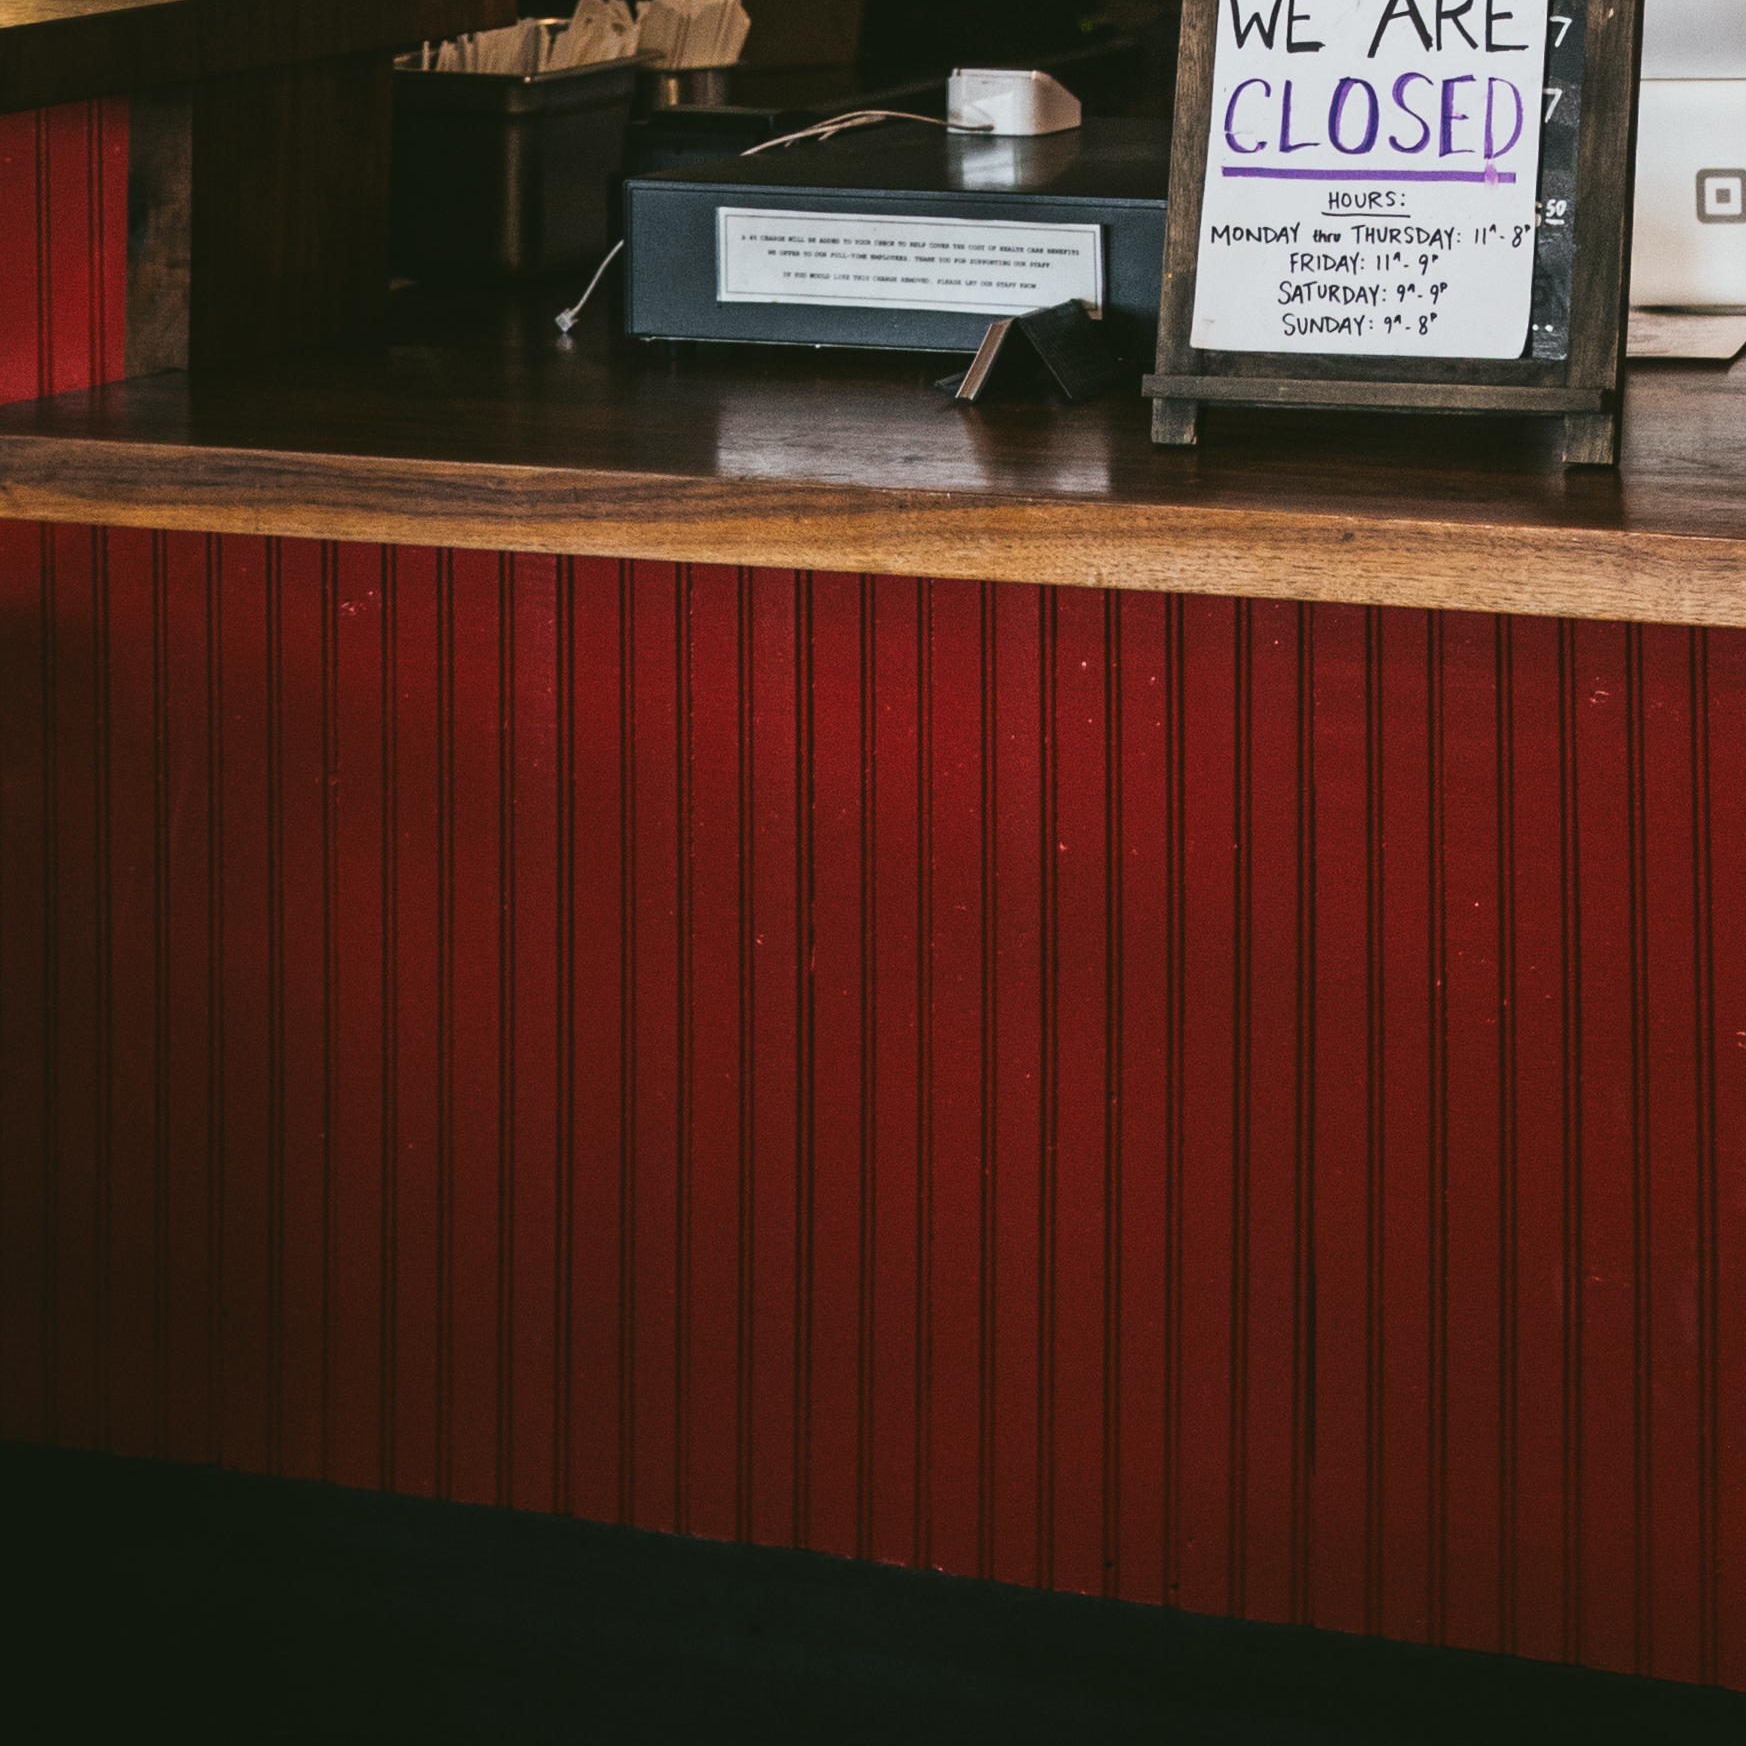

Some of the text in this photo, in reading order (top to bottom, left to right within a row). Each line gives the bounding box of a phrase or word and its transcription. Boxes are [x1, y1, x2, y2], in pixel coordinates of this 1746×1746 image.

[1223, 72, 1523, 159] CLOSED
[1328, 191, 1407, 209] HOURS:
[1211, 222, 1461, 250] MONDAY thru THURSDAY:
[1290, 253, 1365, 273] FRIDAY:
[1278, 281, 1387, 306] SATURDAY:
[1282, 313, 1373, 336] SUNDAY:
